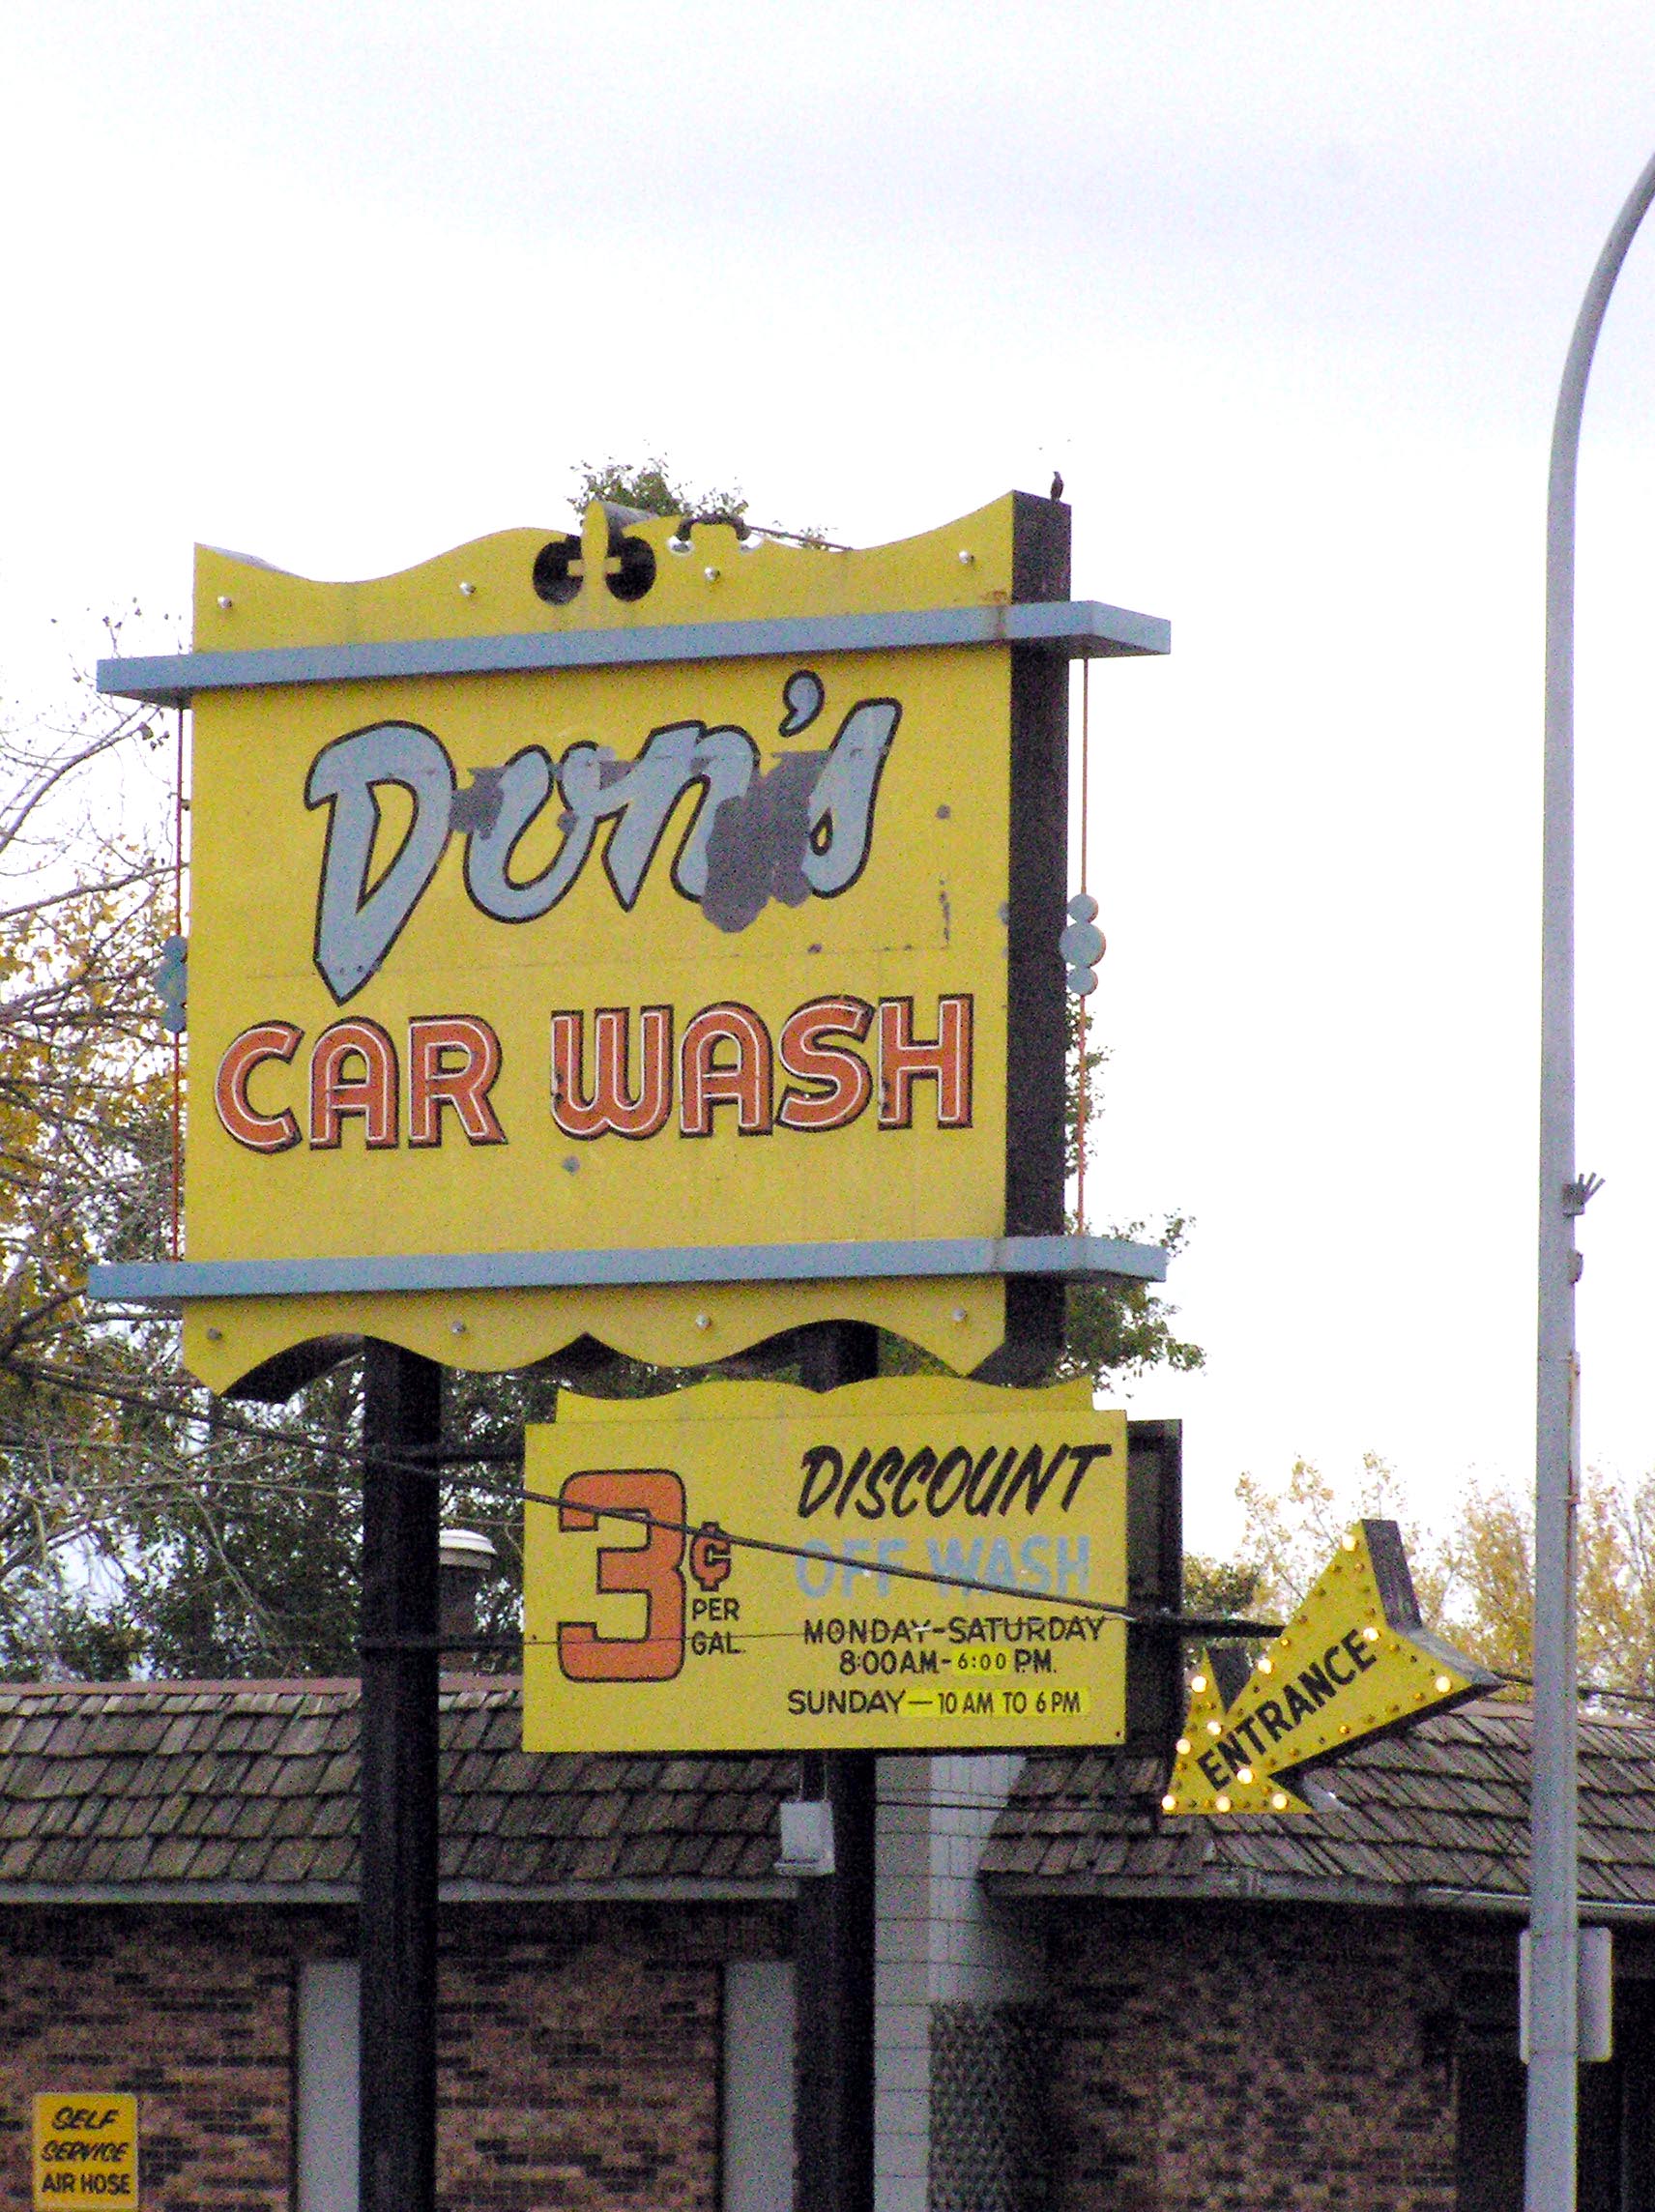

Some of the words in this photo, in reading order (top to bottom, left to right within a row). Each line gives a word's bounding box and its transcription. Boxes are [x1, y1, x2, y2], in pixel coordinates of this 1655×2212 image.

[214, 1015, 508, 1153] CAR
[549, 992, 973, 1140] WASH
[798, 1443, 1112, 1520] DISCOUNT
[795, 1538, 907, 1599] OFF
[922, 1533, 1091, 1597] WASH
[692, 1598, 740, 1621] PER
[939, 1694, 957, 1714] 10
[963, 1693, 993, 1714] AM
[1005, 1692, 1027, 1714] TO
[1051, 1692, 1080, 1713] PM
[1197, 1628, 1377, 1791] ENTRANCE
[52, 2107, 119, 2131] SELF
[42, 2139, 130, 2162] SERVICE
[42, 2172, 75, 2194] AIR
[80, 2172, 131, 2196] HOSE
